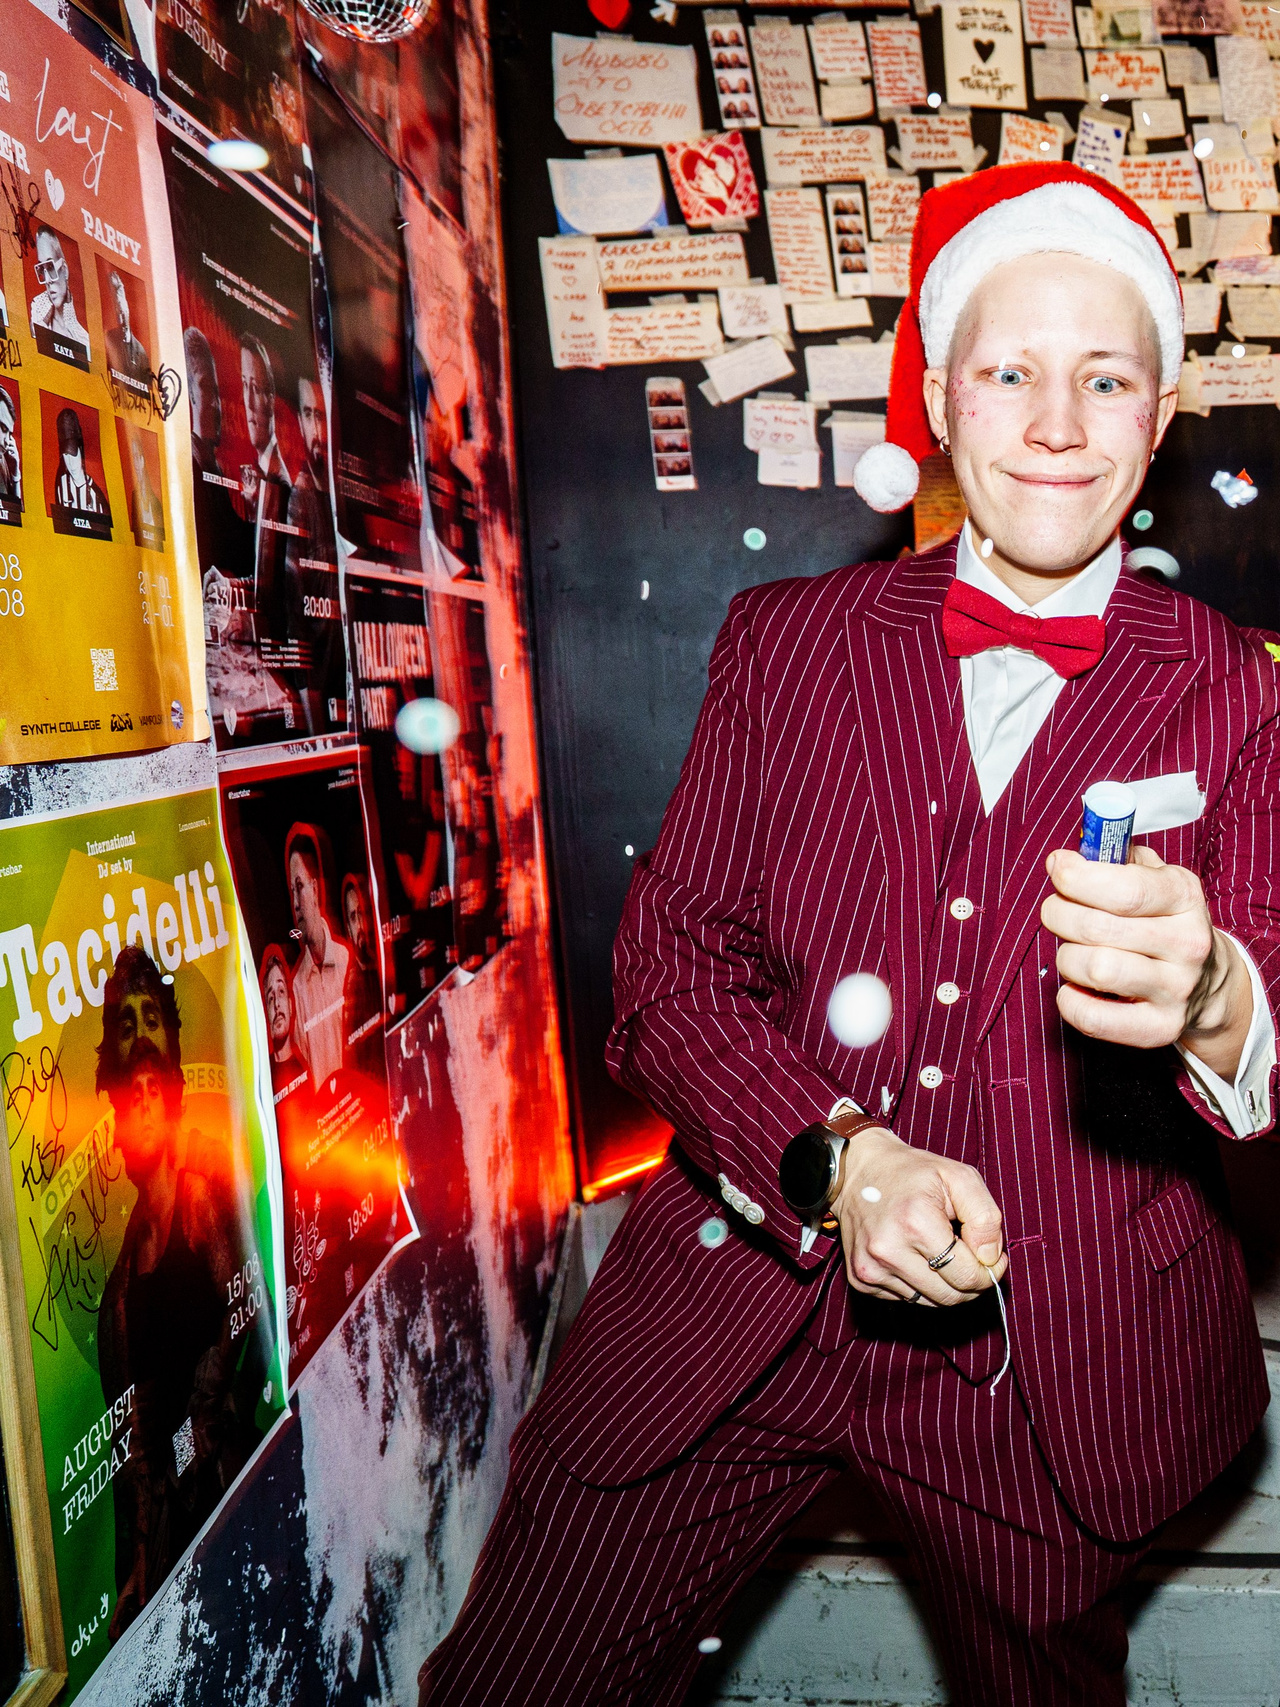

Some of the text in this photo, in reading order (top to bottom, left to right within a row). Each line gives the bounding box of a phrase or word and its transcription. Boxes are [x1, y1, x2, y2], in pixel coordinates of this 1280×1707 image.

[167, 0, 228, 71] TUESDAY
[81, 208, 142, 266] PARTY
[53, 342, 75, 359] KAYA
[303, 596, 332, 618] 20:00
[353, 621, 428, 682] HALLOWEEN
[21, 719, 102, 736] SYNTH COLLEGE
[360, 686, 389, 732] PARTY
[86, 831, 136, 857] International
[98, 858, 133, 879] DJ set by
[0, 861, 229, 1043] Tacidelli
[362, 1117, 389, 1163] 04/12
[348, 1192, 374, 1241] 19:30
[226, 1252, 261, 1306] 15/08
[230, 1285, 263, 1340] 21:00
[61, 1384, 135, 1491] AUGUST
[62, 1427, 133, 1535] FRIDAY
